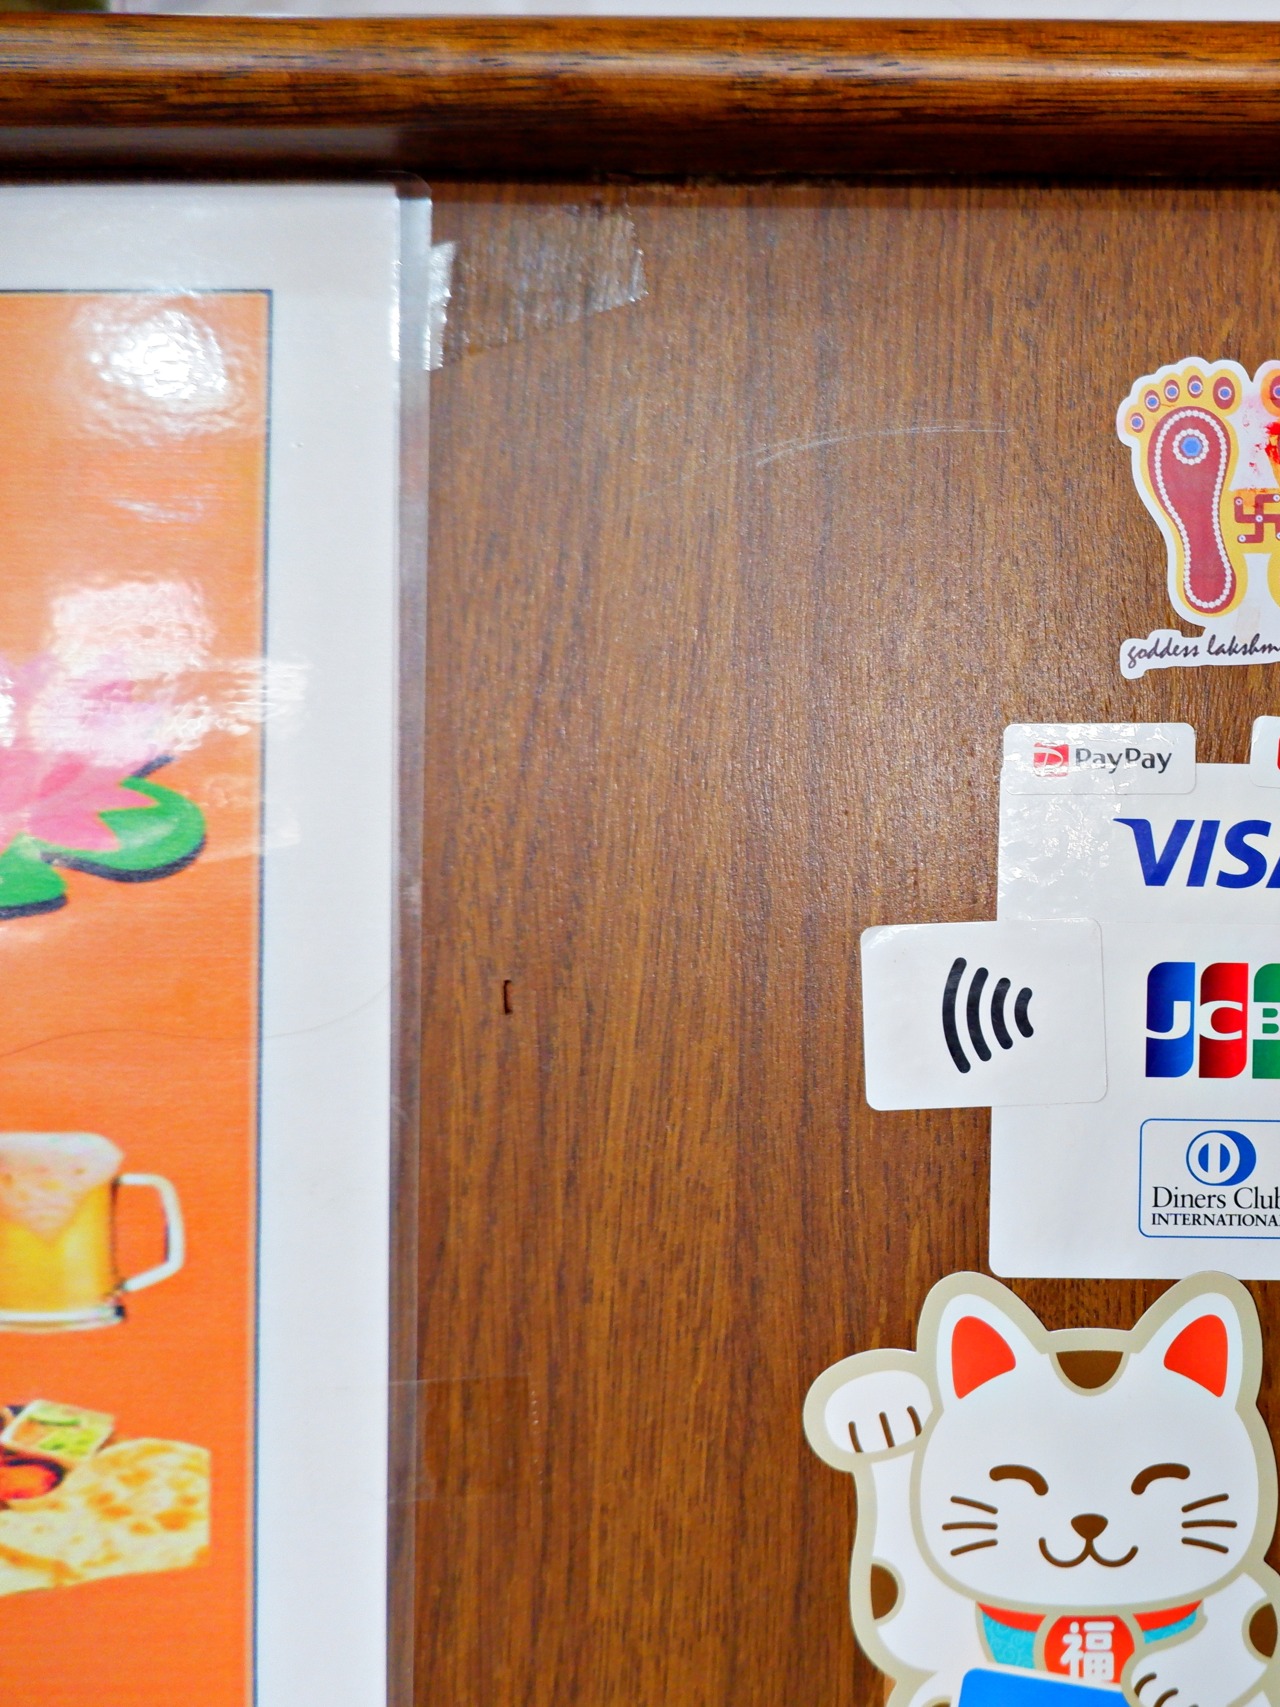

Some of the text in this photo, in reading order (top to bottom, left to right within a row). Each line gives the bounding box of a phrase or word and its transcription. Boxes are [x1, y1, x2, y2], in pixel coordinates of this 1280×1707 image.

[1126, 637, 1200, 669] goddess
[1075, 747, 1173, 774] PayPay
[1151, 1186, 1227, 1209] Diners
[1060, 1621, 1116, 1682] 福
